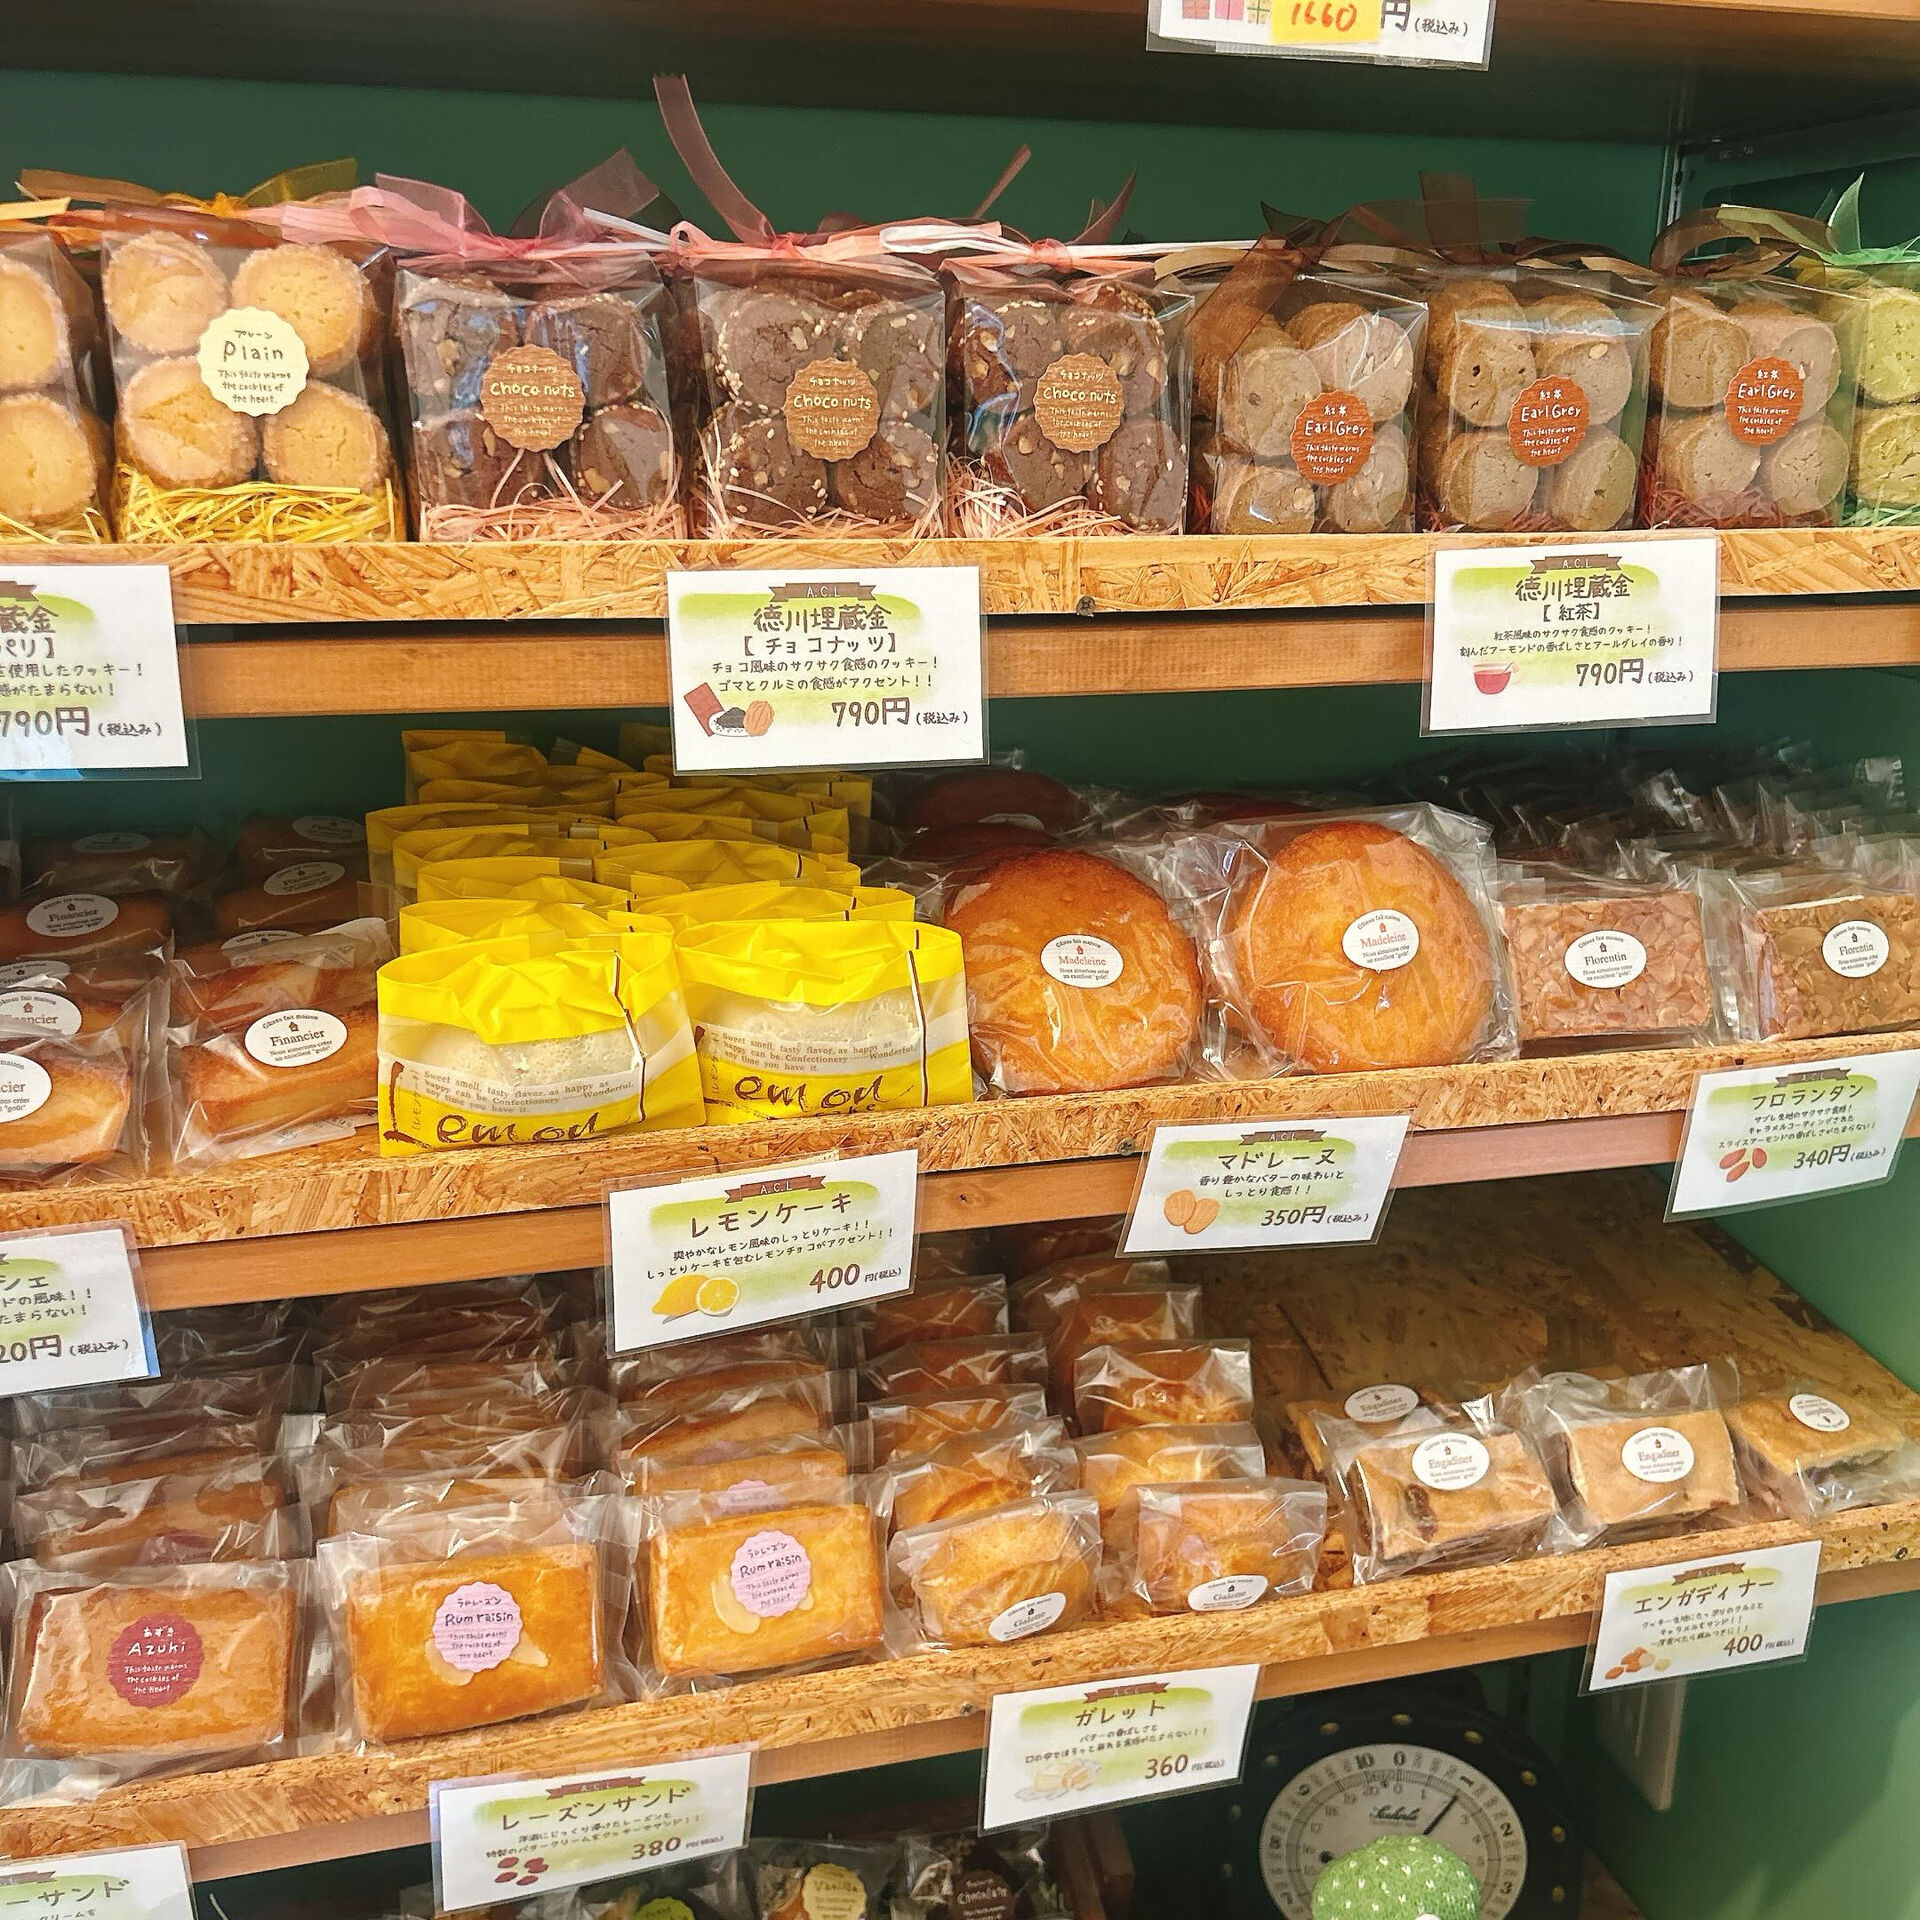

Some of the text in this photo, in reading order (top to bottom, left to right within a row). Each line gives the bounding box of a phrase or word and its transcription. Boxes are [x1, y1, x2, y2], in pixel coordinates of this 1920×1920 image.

[1291, 0, 1357, 32] 1660
[223, 340, 284, 362] Plain
[490, 382, 575, 398] Choco nuts
[793, 393, 872, 410] Choco nuts
[1043, 386, 1117, 404] Choco nuts
[1514, 572, 1634, 602] 徳川埋蔵金
[753, 603, 892, 633] 徳川埋蔵金
[1543, 602, 1600, 623] 【紅茶】
[1576, 658, 1645, 687] 790円
[0, 706, 90, 738] 790円
[832, 696, 911, 728] 790円
[1360, 932, 1407, 949] Madeleine
[1839, 942, 1874, 956] Florentin
[1058, 955, 1107, 966] Madeleine
[1584, 952, 1627, 966] Florentin
[270, 1030, 325, 1046] Financier
[722, 1033, 746, 1044] Sweet
[780, 1046, 801, 1056] tasty
[838, 1047, 848, 1055] as
[853, 1044, 879, 1055] happy
[724, 1042, 746, 1055] happy
[751, 1050, 766, 1059] can
[724, 1050, 738, 1060] any
[742, 1054, 762, 1065] time
[764, 1060, 780, 1069] you
[784, 1063, 806, 1071] have
[424, 1071, 451, 1084] Sweet
[487, 1086, 509, 1098] tasty
[565, 1083, 593, 1094] happy
[455, 1090, 472, 1098] can
[444, 1094, 464, 1106] time
[469, 1101, 486, 1112] you
[491, 1104, 514, 1113] have
[1752, 1084, 1864, 1111] フロランタン
[1218, 1148, 1336, 1171] マドレーヌ
[1793, 1144, 1851, 1169] 340円
[691, 1192, 852, 1238] レモンケーキ
[1261, 1205, 1327, 1228] 350円
[808, 1263, 861, 1294] 400
[740, 1554, 802, 1578] Rum raisin
[1633, 1579, 1774, 1614] エンガディナー
[445, 1612, 514, 1627] Rum raisin
[128, 1641, 186, 1656] Azuki
[1723, 1633, 1763, 1657] 400
[1076, 1699, 1166, 1728] ガレット
[1143, 1754, 1189, 1780] 360
[1393, 1751, 1406, 1768] 0
[503, 1786, 691, 1831] レーズンサンド
[632, 1836, 681, 1860] 380
